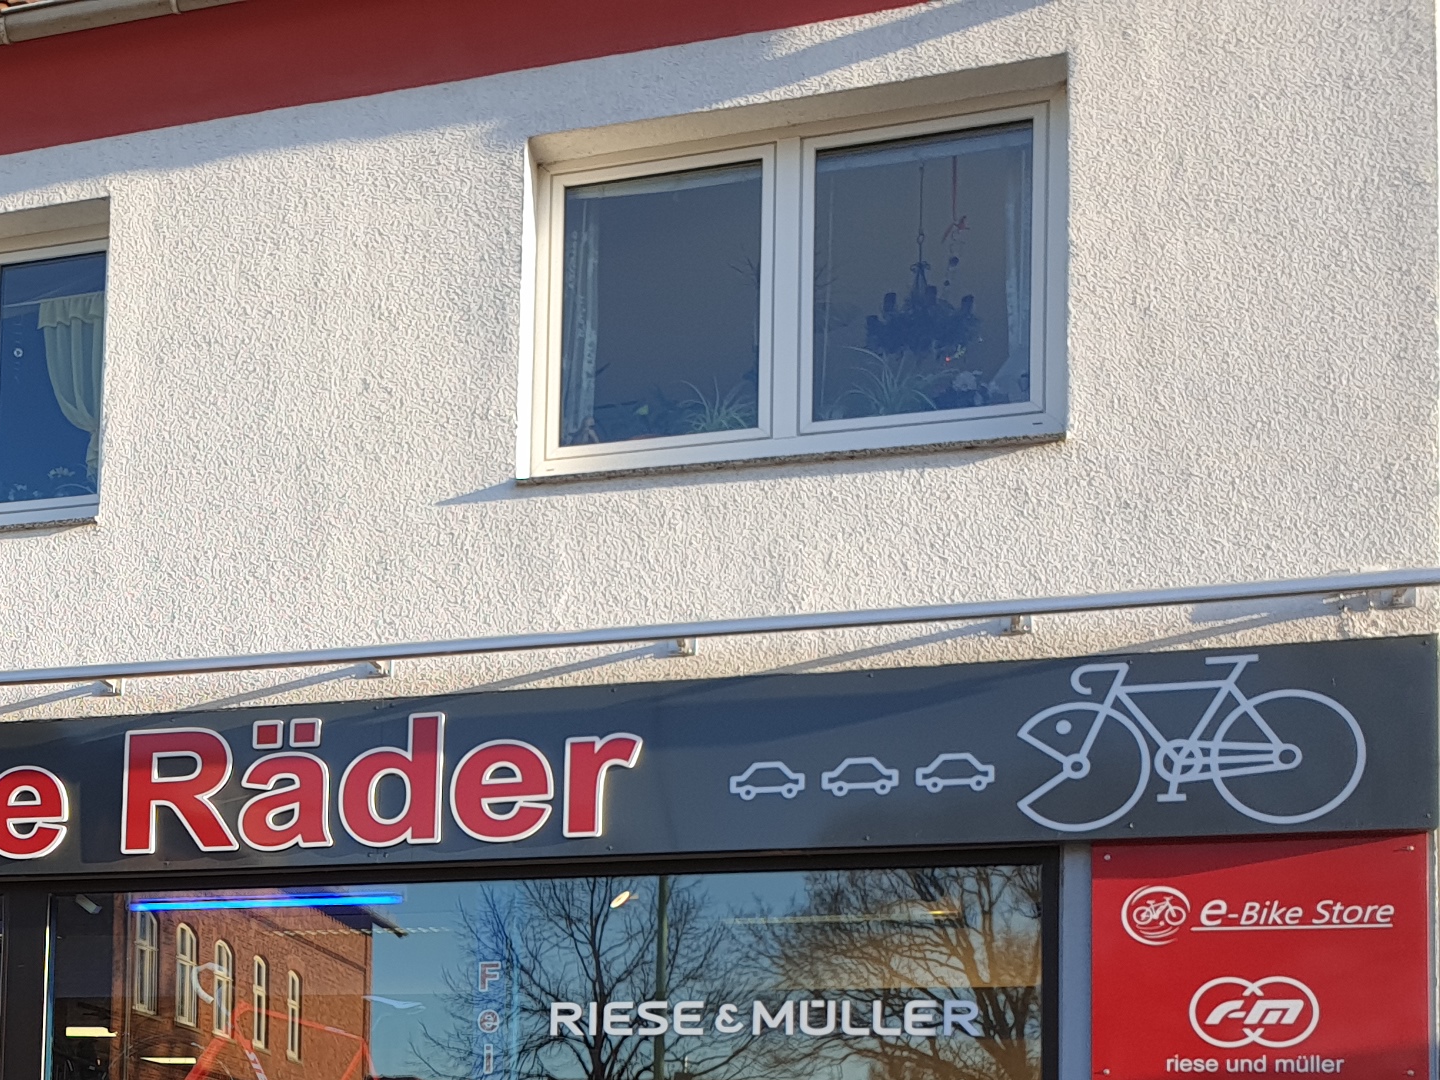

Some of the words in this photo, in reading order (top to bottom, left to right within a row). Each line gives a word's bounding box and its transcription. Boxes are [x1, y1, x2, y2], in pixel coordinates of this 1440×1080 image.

[119, 711, 644, 856] Räder
[1199, 896, 1303, 927] e-Bike
[1311, 899, 1396, 924] Store
[549, 999, 705, 1038] RIESE
[714, 1003, 745, 1034] &
[752, 998, 981, 1038] MÜLLER
[1165, 1053, 1219, 1074] riese
[1225, 1053, 1267, 1074] und
[1274, 1053, 1345, 1075] müller
